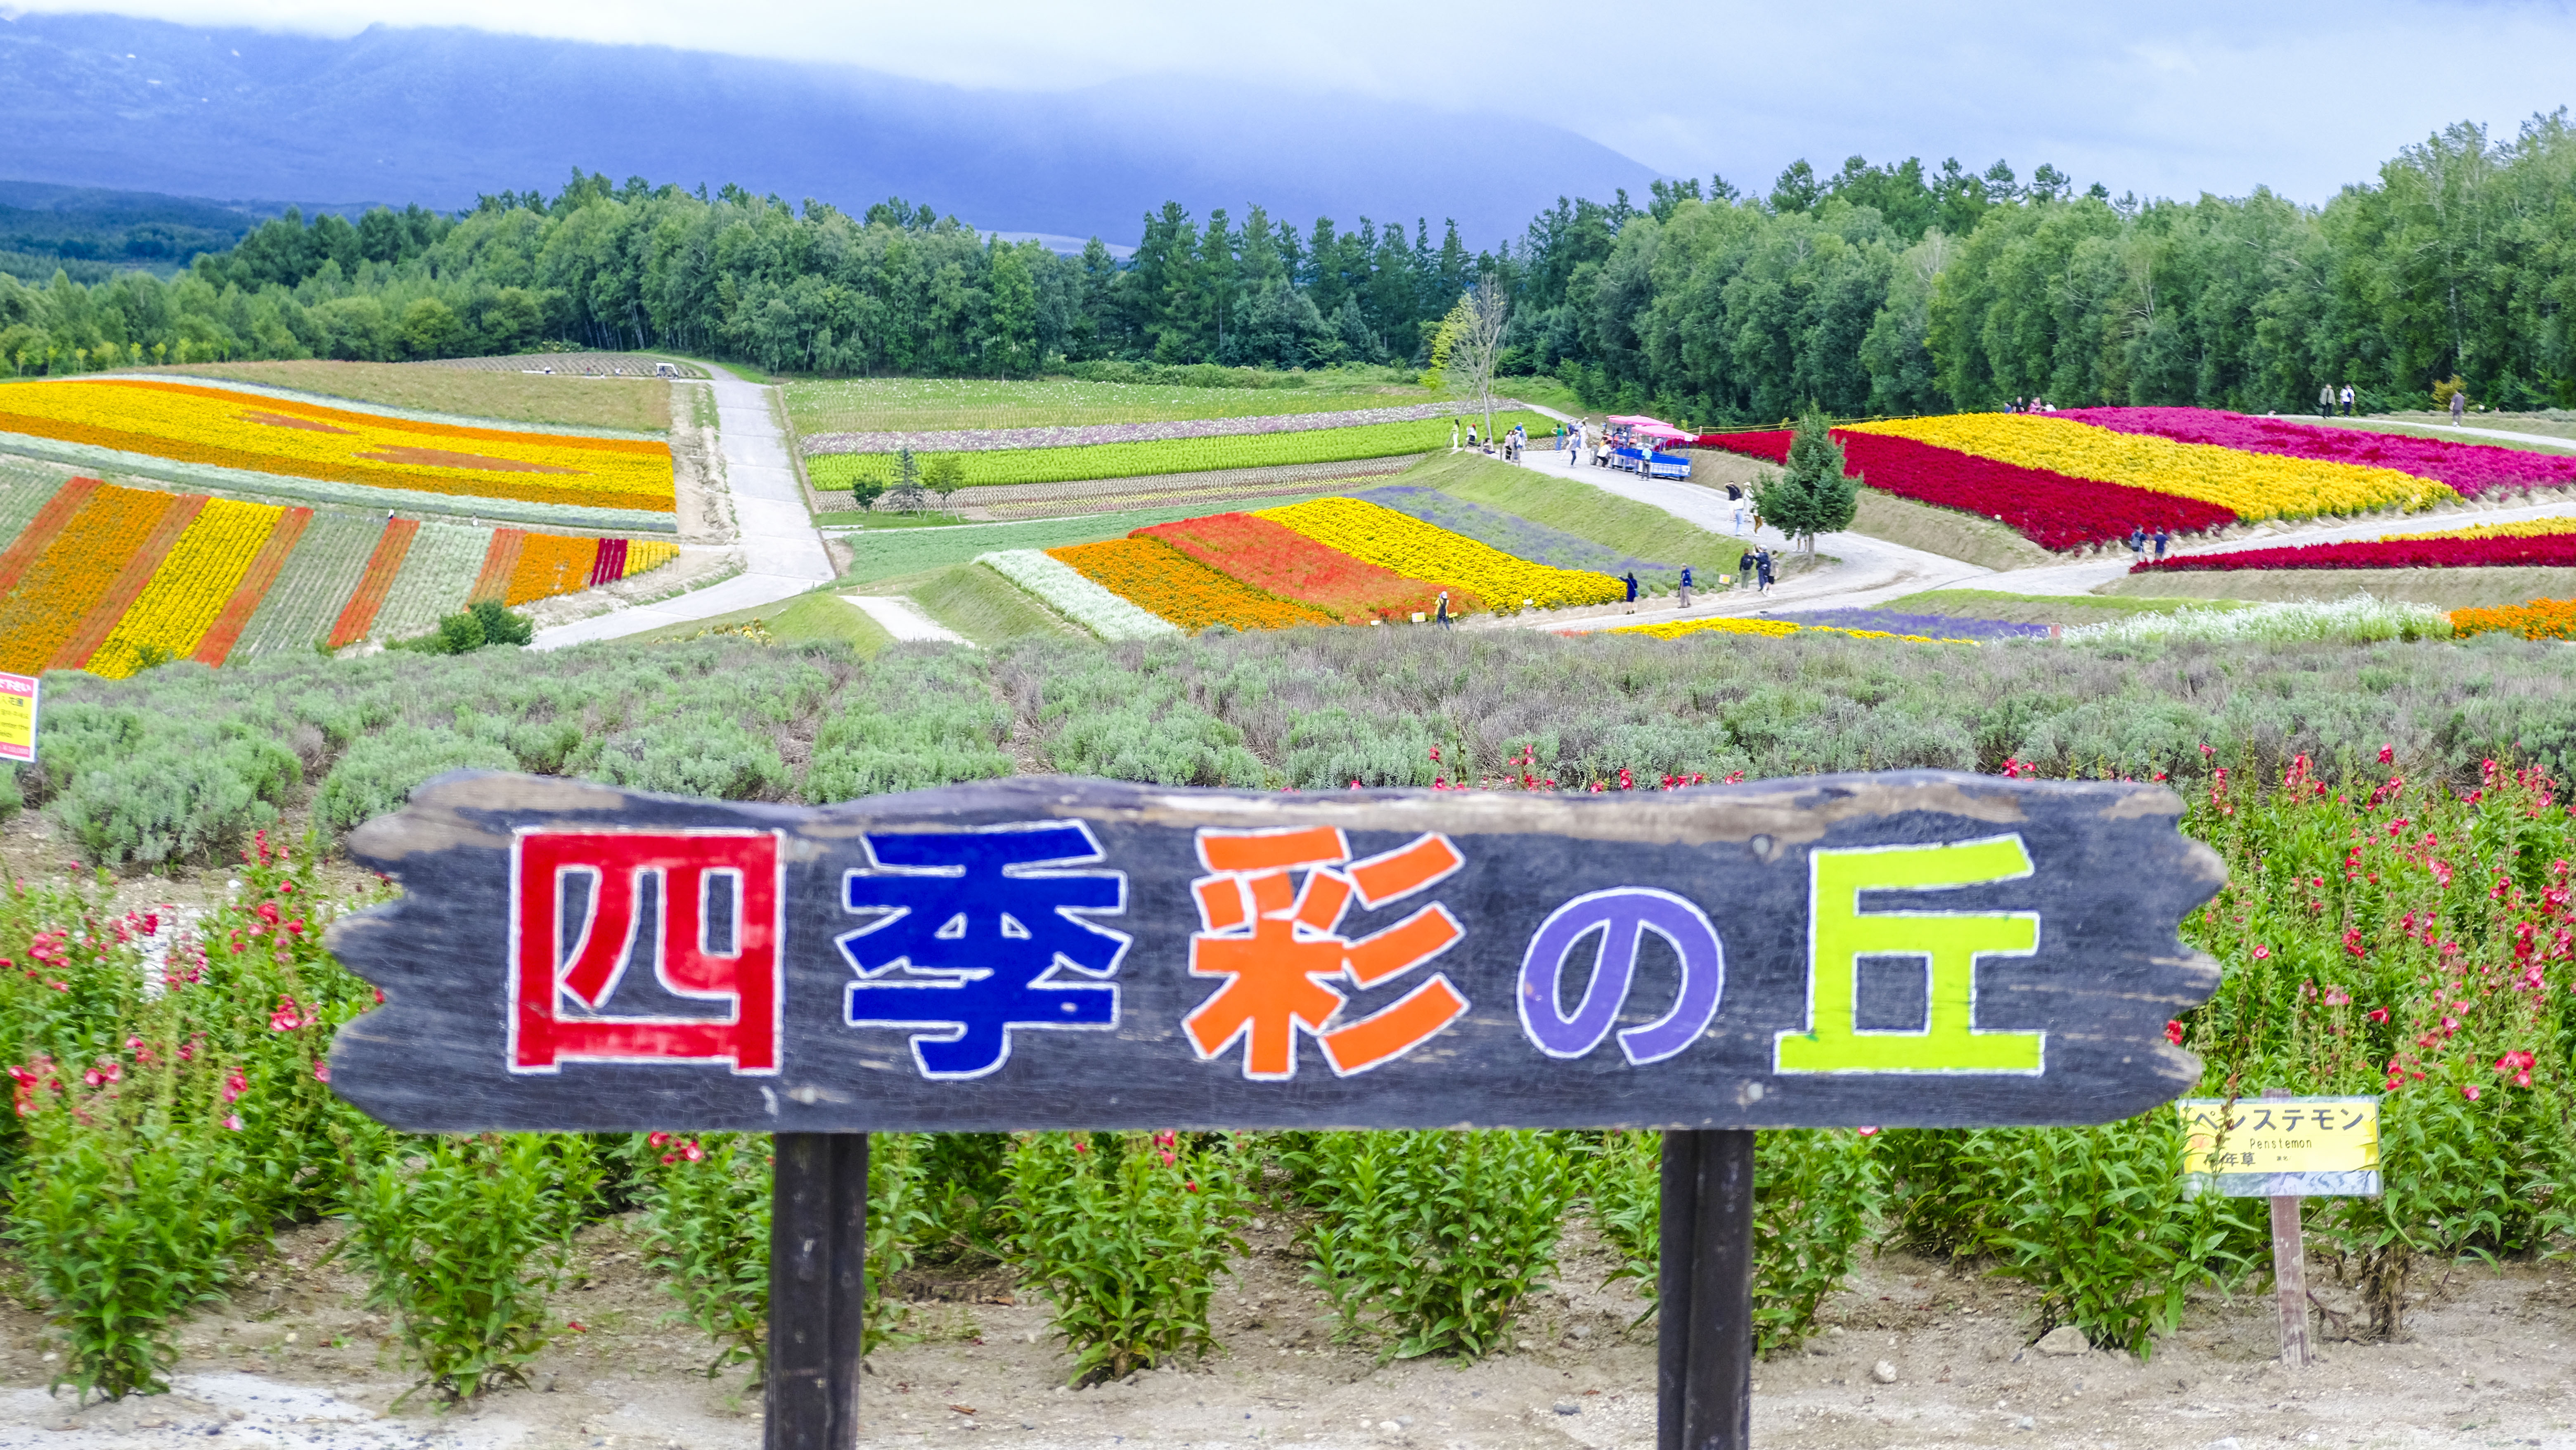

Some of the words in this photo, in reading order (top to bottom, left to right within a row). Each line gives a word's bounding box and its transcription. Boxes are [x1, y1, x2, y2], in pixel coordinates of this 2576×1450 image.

[507, 819, 2046, 1081] 四季彩の丘
[2250, 1137, 2312, 1149] Penstemon
[2203, 1152, 2256, 1166] 年草
